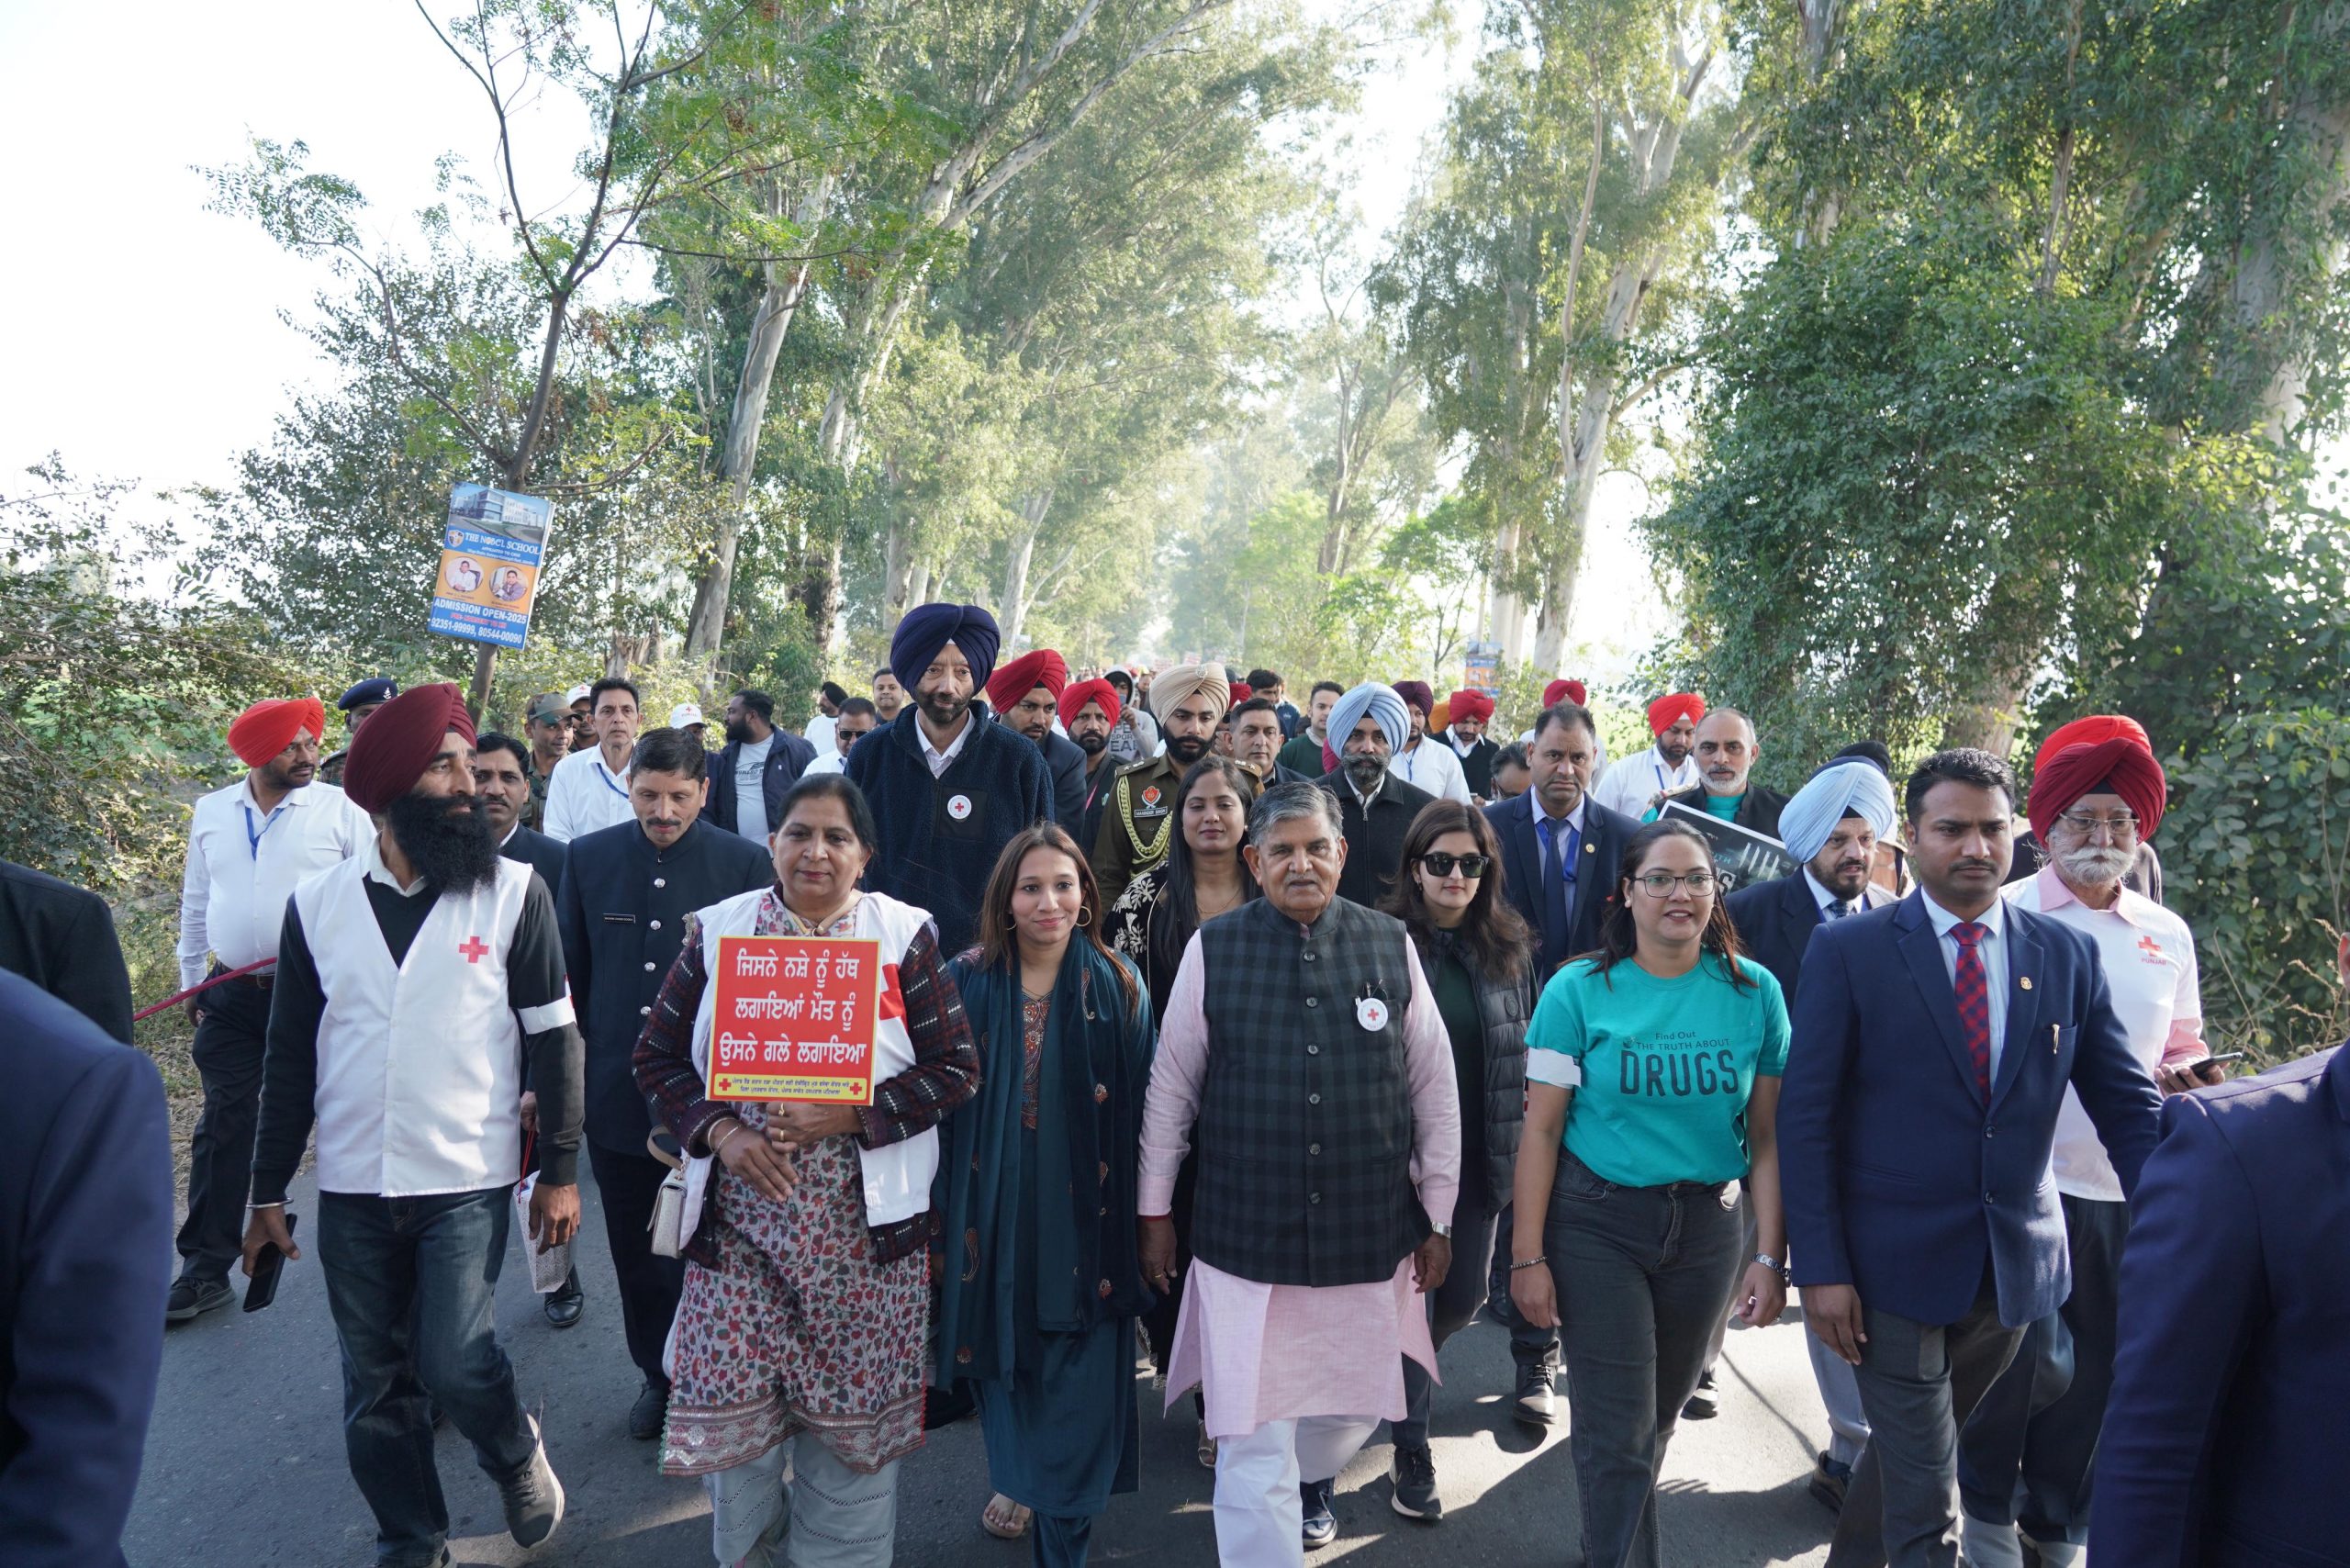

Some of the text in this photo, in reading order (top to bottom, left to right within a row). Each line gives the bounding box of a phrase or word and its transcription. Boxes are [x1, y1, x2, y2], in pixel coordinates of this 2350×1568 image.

[465, 532, 479, 543] THE
[507, 541, 540, 555] SCHOOL
[434, 598, 481, 616] ADMISSION
[482, 608, 528, 624] OPEN-2025
[736, 947, 779, 978] ਜਿਸਨੇ
[815, 948, 831, 989] ਨੂੰ
[735, 990, 856, 1032] ਲਗਾਇਆਂ ਮੌਤ ਨੂੰ
[764, 1033, 792, 1062] ਗਲੇ
[797, 1035, 867, 1065] ਲਗਾਇਆ
[1636, 1038, 1730, 1051] THE TRUTH ABOUT
[1655, 1031, 1696, 1040] Find Out
[1619, 1049, 1740, 1097] DRUGS
